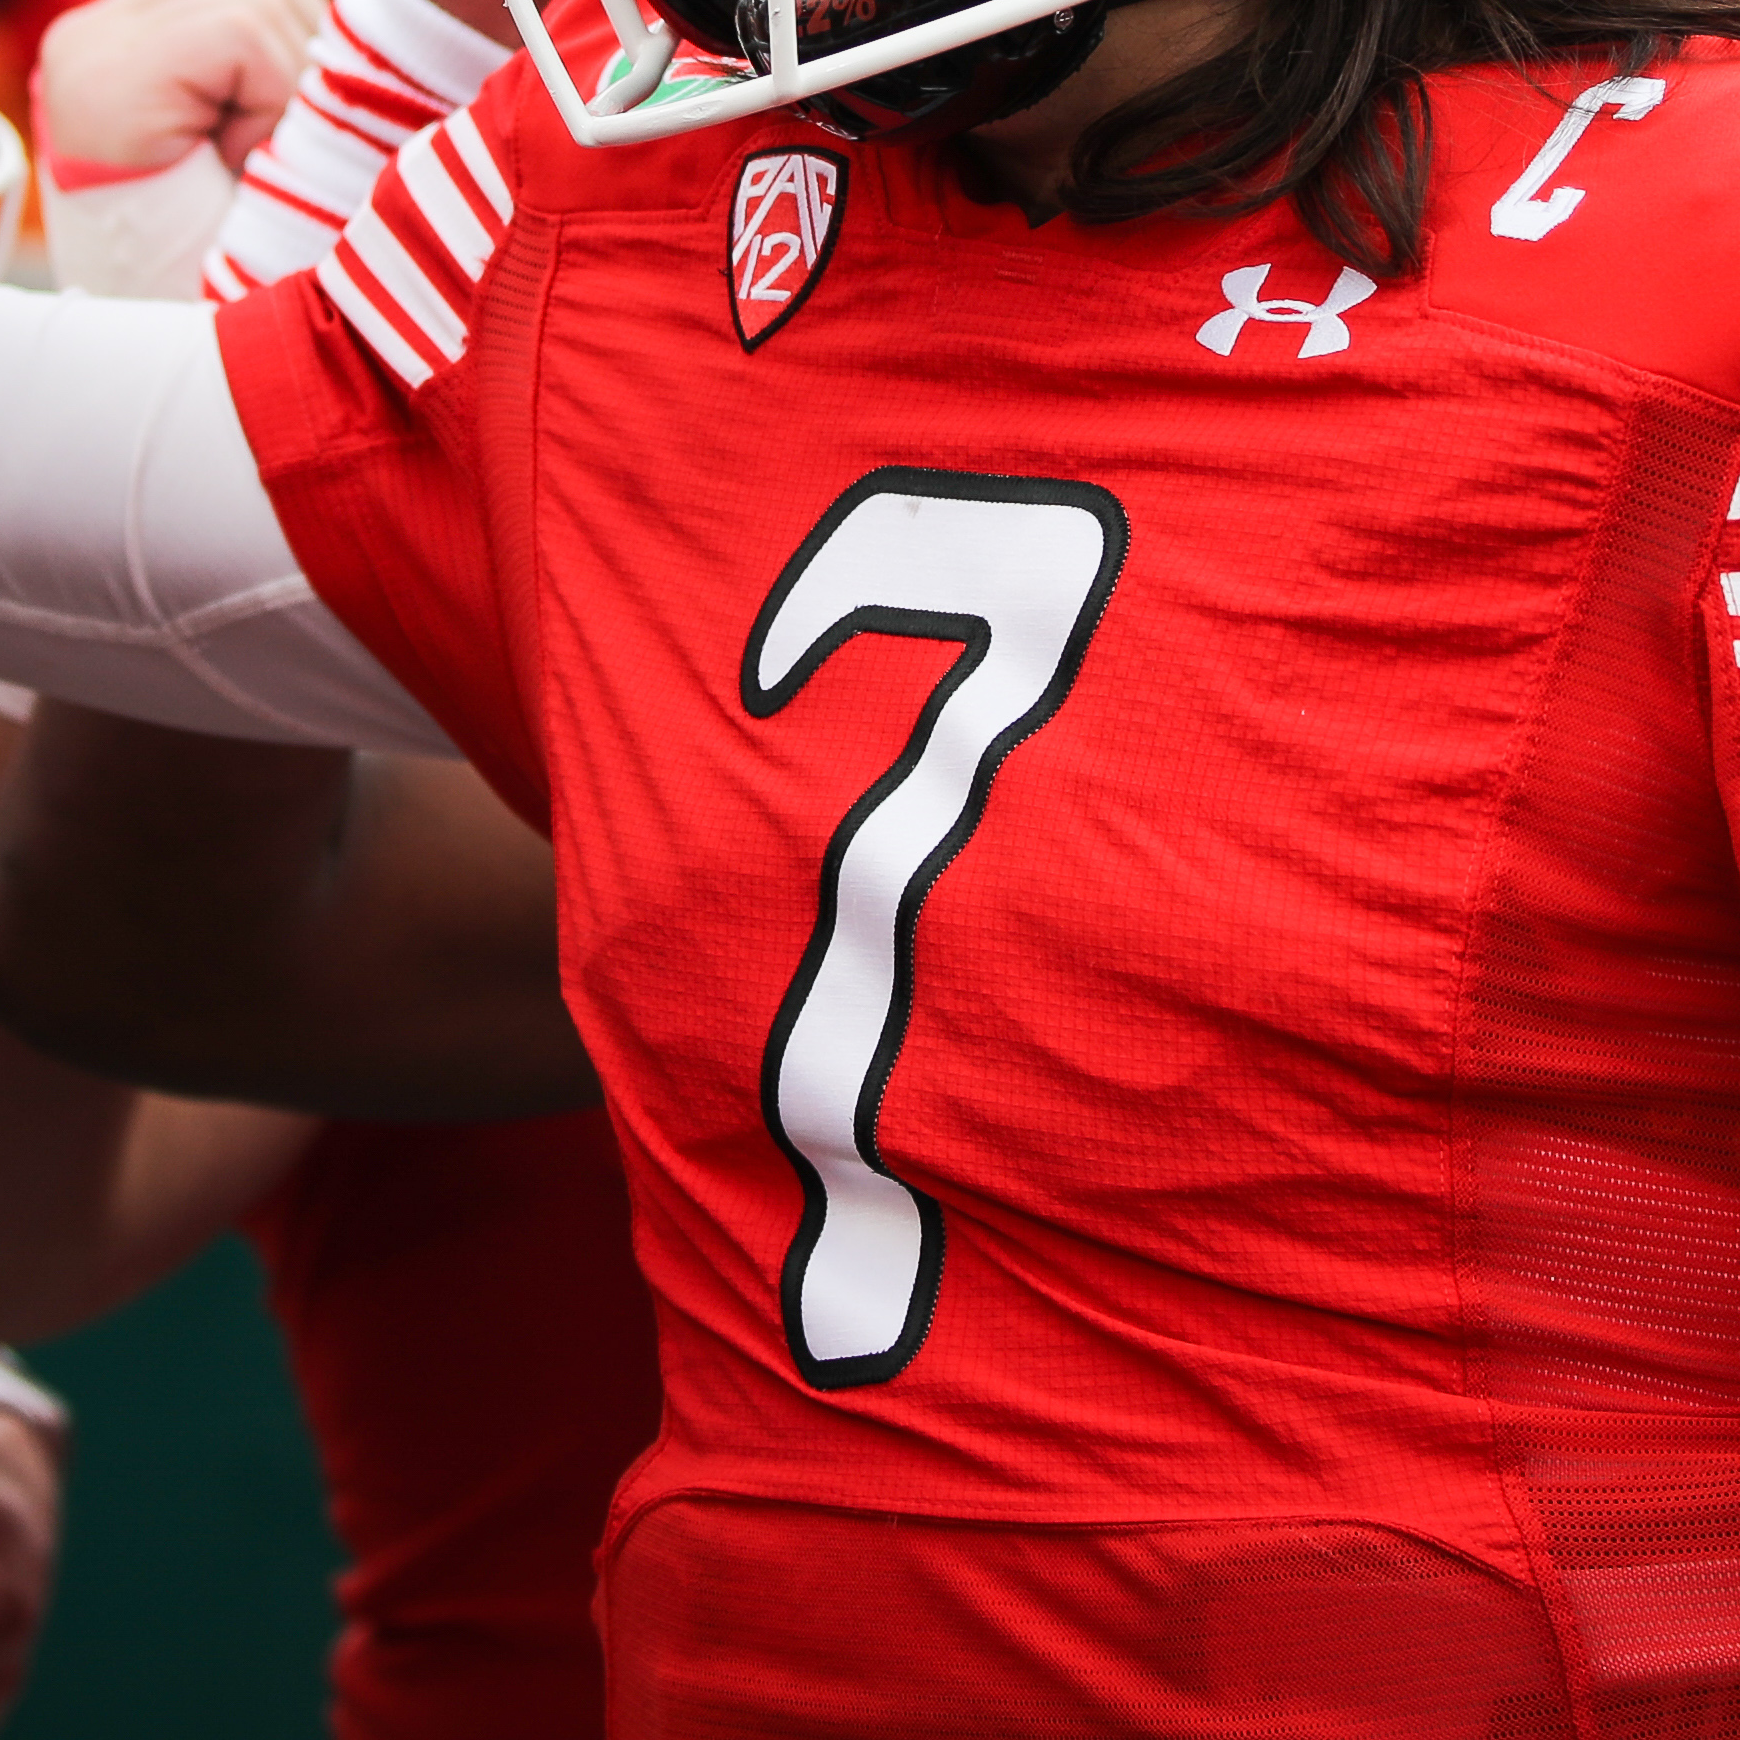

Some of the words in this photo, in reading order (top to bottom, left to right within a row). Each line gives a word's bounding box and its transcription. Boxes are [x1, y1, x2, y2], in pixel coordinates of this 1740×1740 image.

[733, 154, 838, 271] PAC
[1490, 76, 1667, 242] C
[738, 231, 802, 302] 12
[742, 467, 1130, 1390] 7
